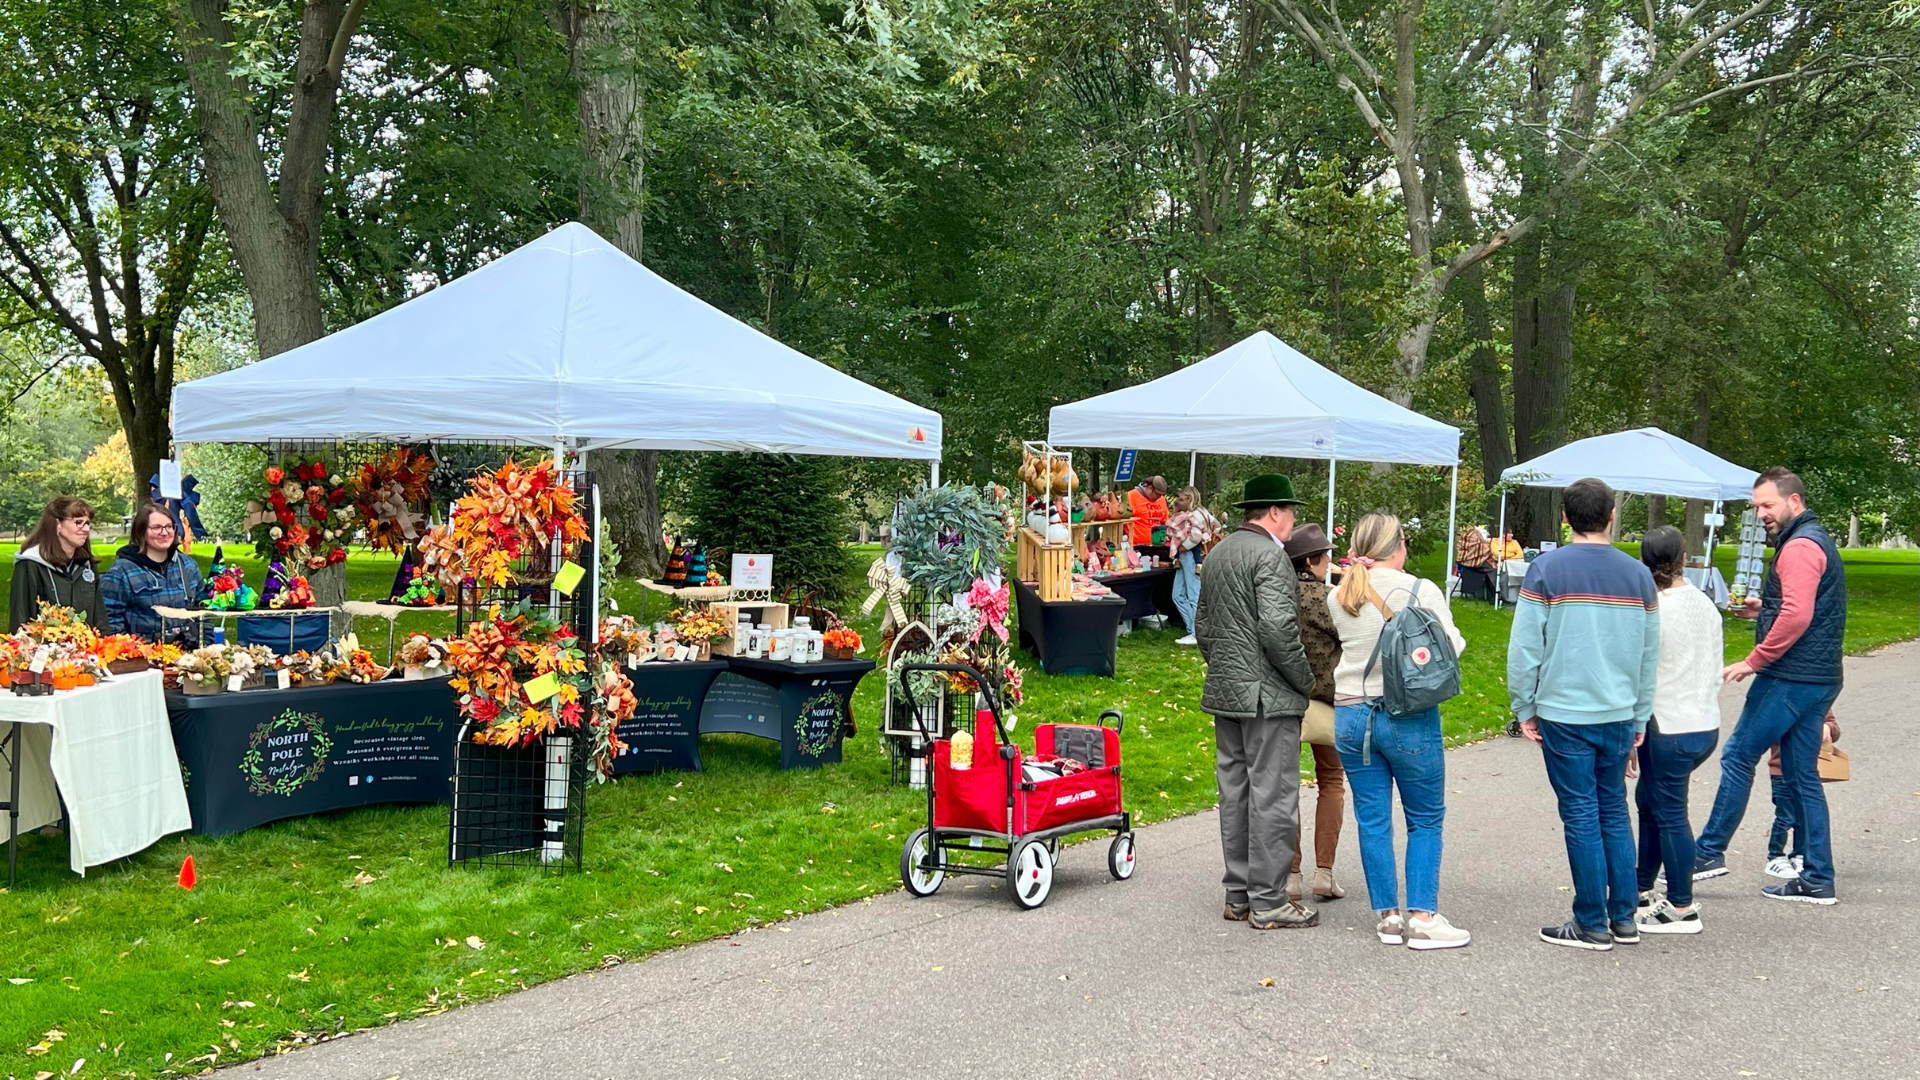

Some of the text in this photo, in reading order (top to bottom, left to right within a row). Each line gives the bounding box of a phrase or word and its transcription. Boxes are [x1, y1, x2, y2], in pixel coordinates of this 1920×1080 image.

[811, 708, 834, 717] NORTH
[812, 720, 830, 728] POLE
[267, 732, 309, 748] NORTH
[271, 747, 303, 762] POLE
[268, 759, 305, 777] Nostalgia
